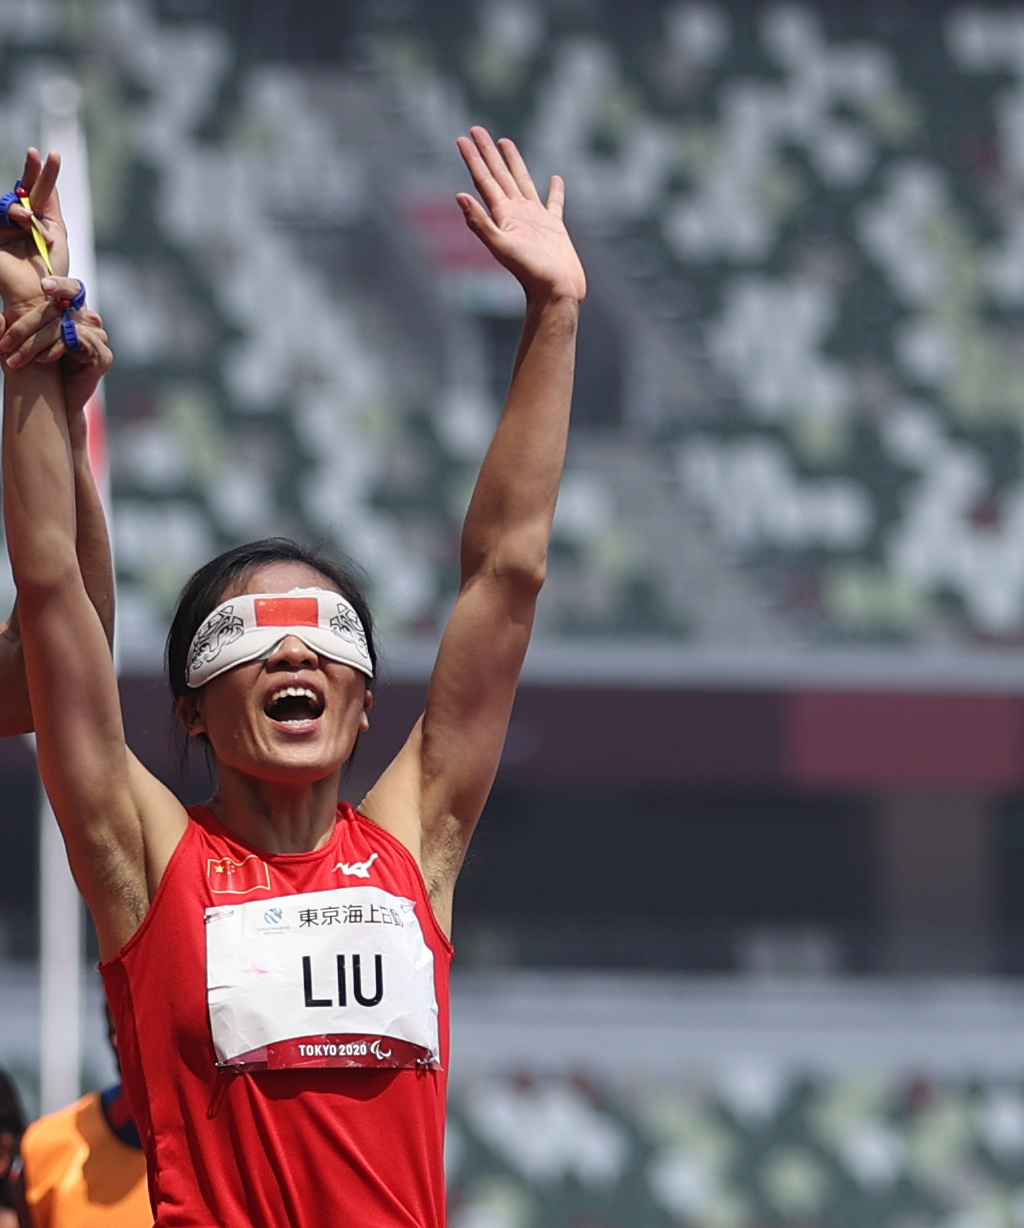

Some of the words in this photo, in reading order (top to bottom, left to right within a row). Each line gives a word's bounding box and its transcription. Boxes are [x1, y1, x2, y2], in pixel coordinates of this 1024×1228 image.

[302, 954, 384, 1008] LIU
[298, 1044, 337, 1057] TOKYO
[338, 1043, 367, 1056] 2020
